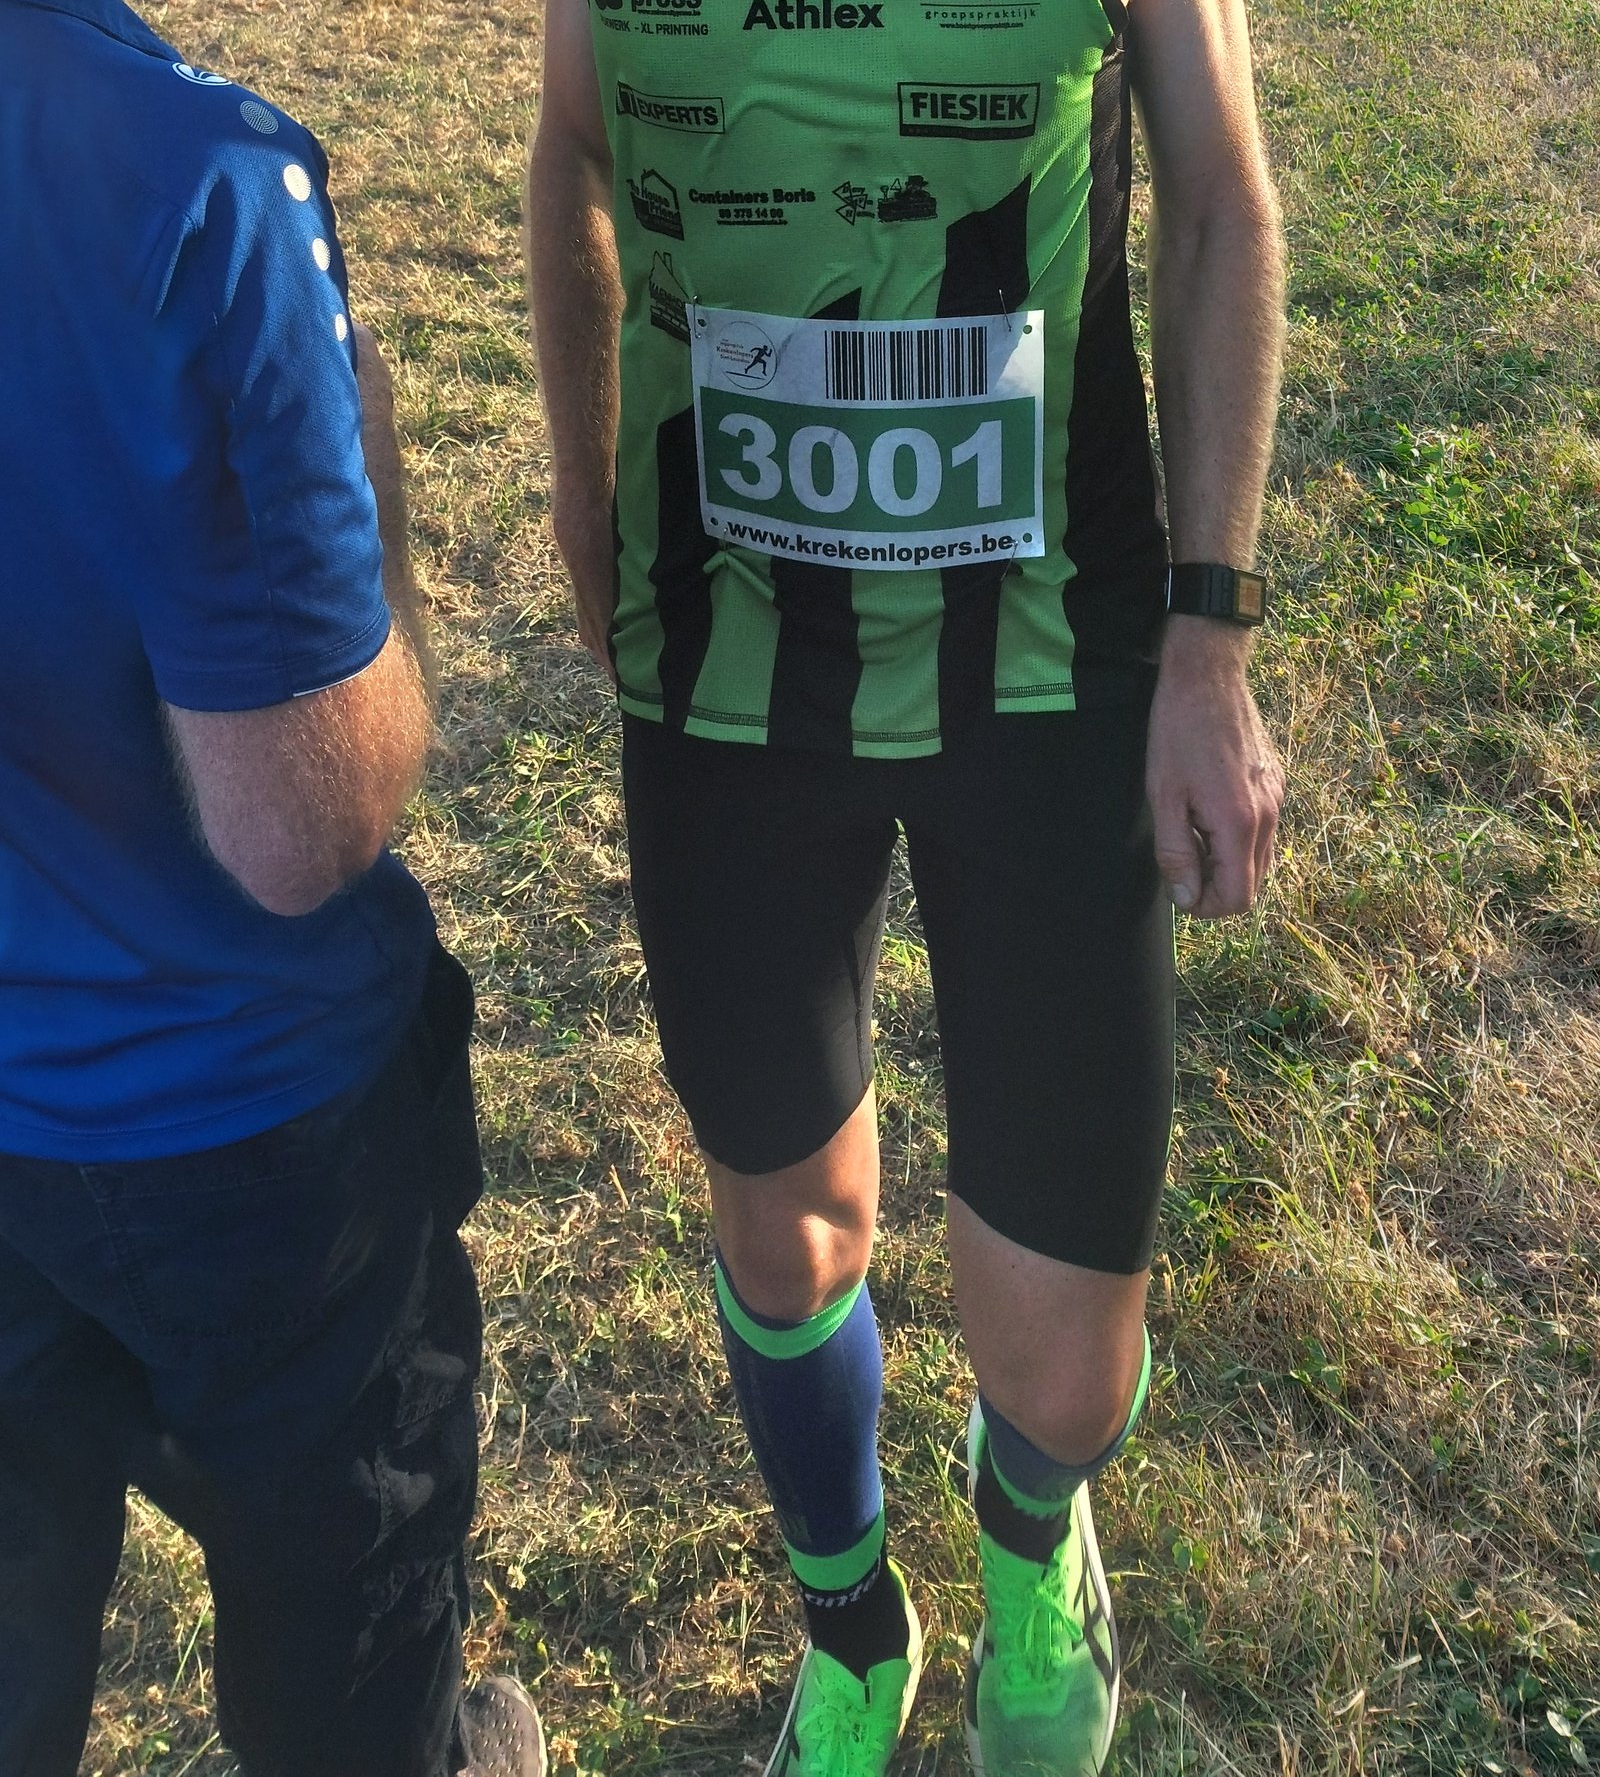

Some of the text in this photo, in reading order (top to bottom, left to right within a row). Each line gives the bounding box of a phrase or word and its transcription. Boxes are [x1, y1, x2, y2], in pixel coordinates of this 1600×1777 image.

[641, 22, 654, 35] XL
[656, 23, 709, 36] PRINTING
[924, 8, 1037, 22] groepspraktijk
[636, 98, 719, 127] EXPERTS
[910, 92, 1029, 121] FIESIEK
[688, 188, 816, 204] Containers Boris
[718, 412, 1003, 517] 3001
[727, 521, 1014, 565] www.krekenlopers.be
